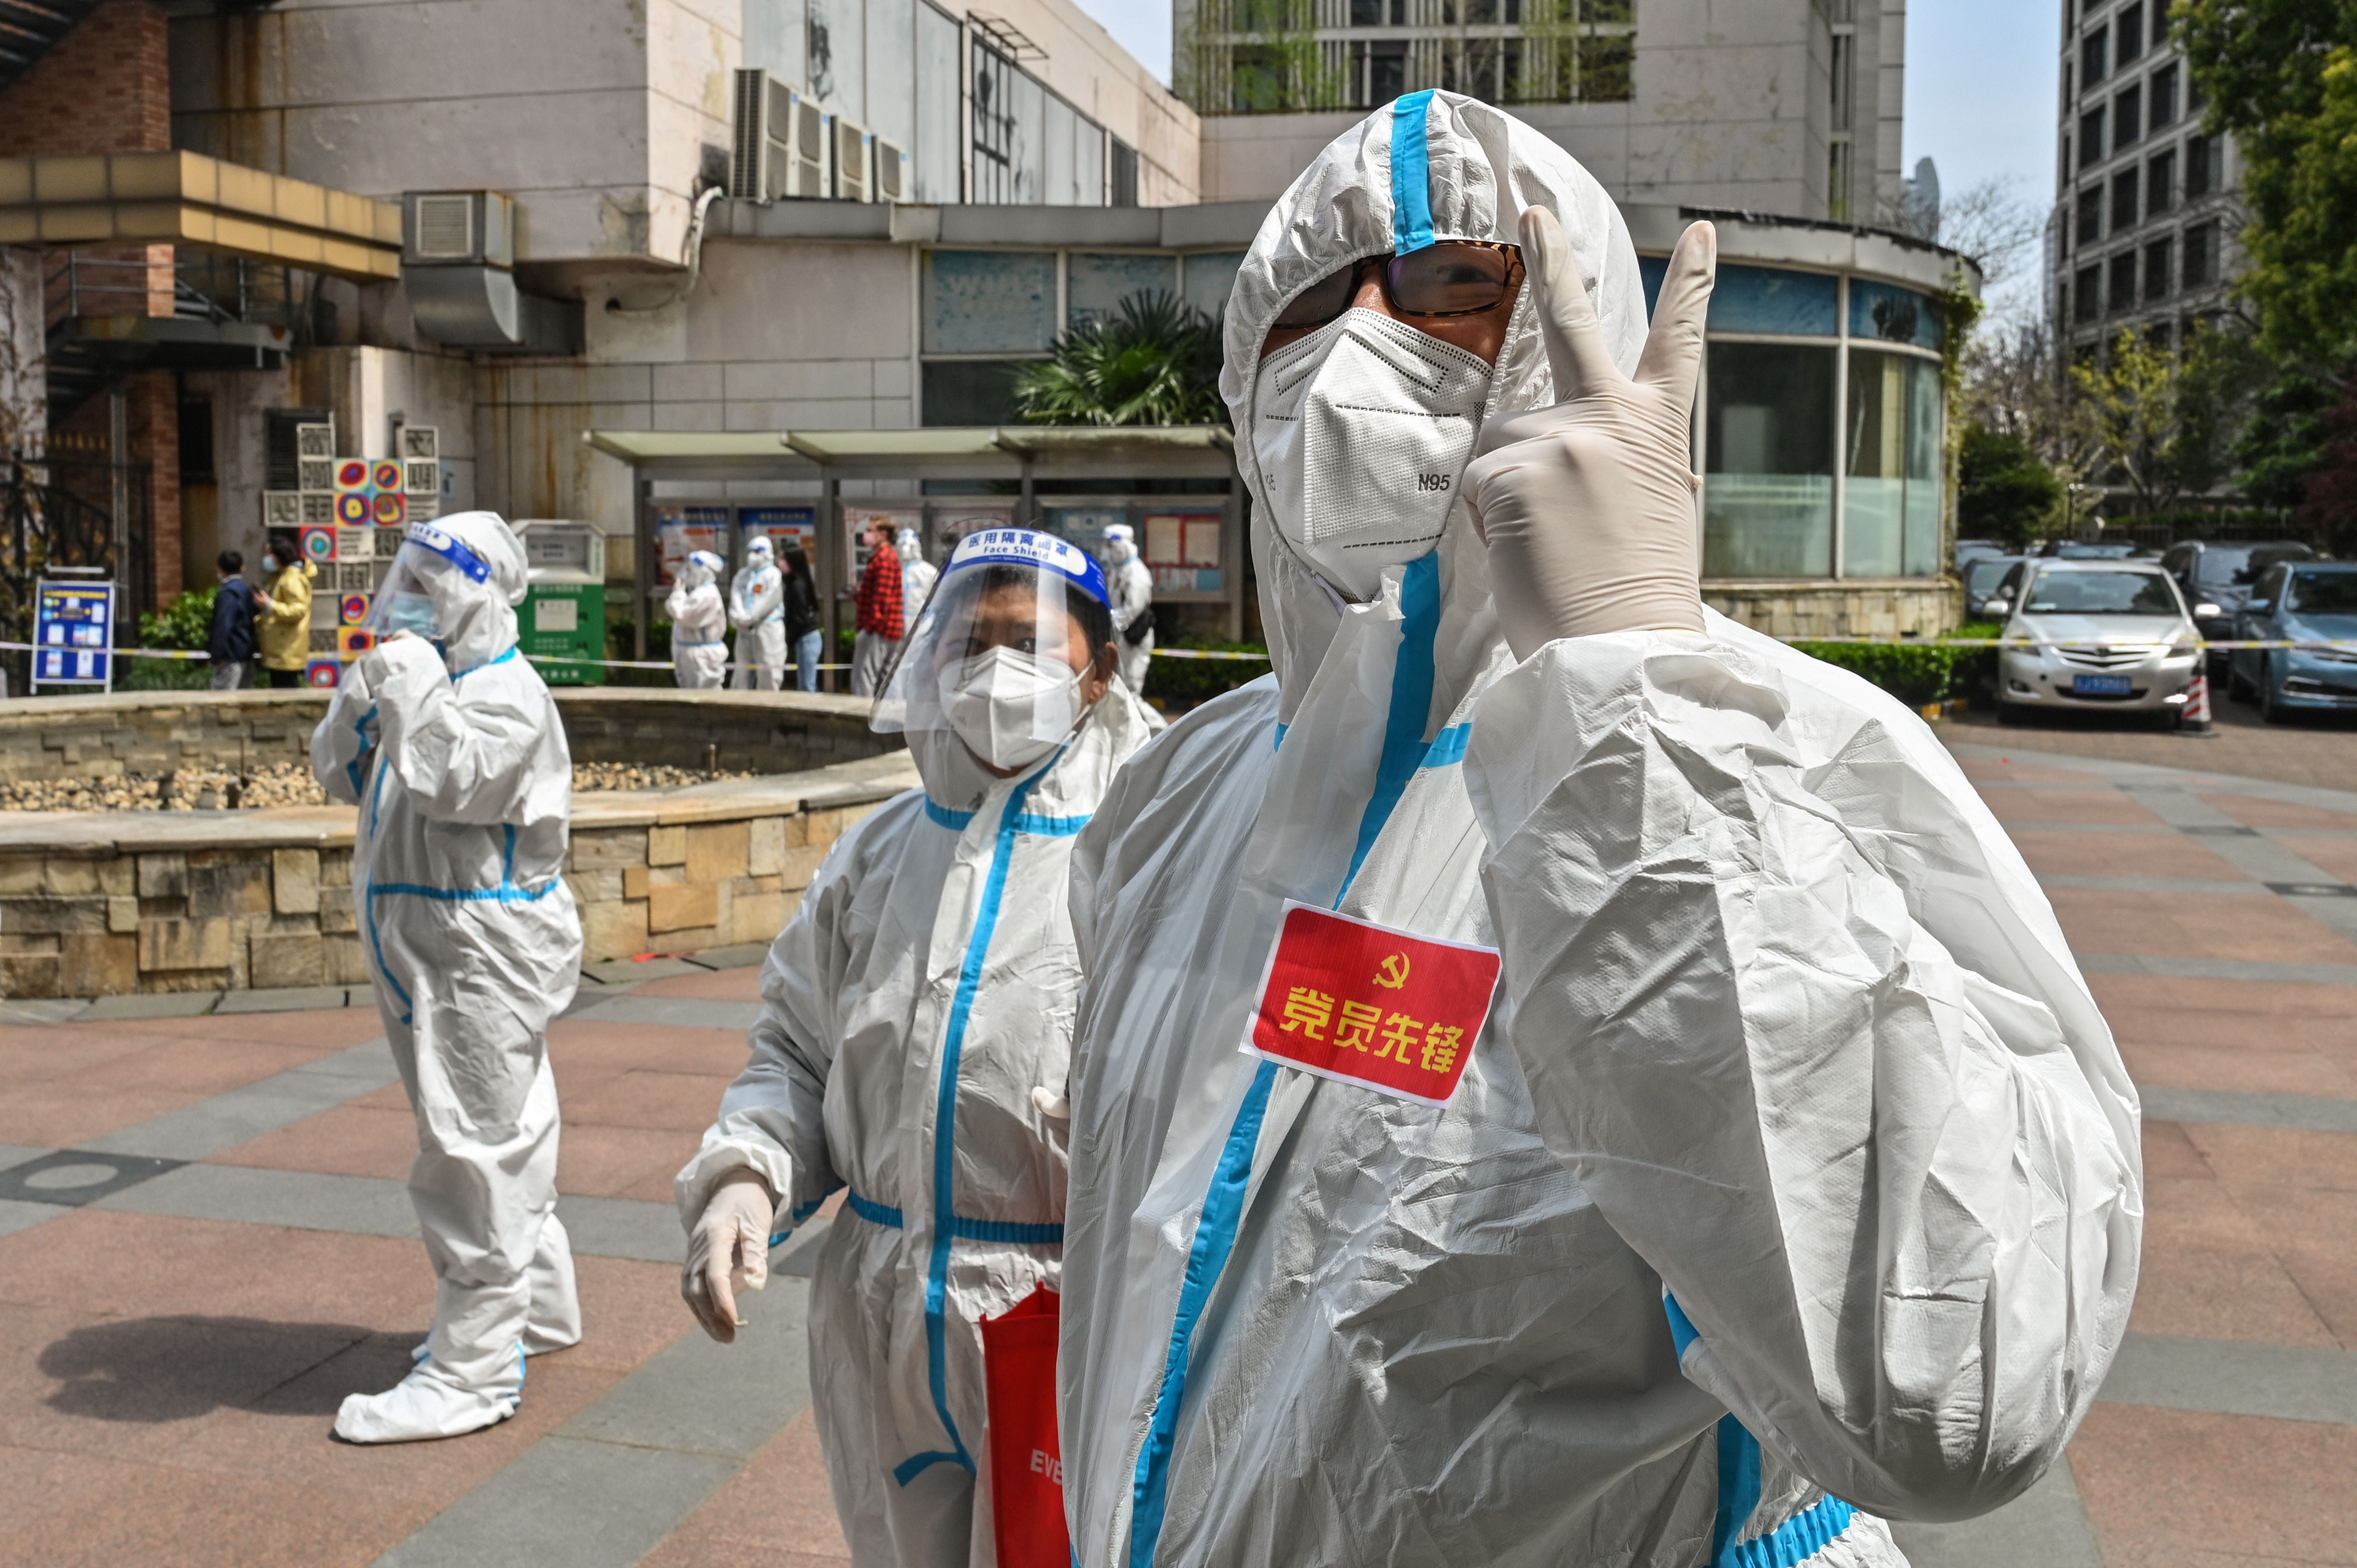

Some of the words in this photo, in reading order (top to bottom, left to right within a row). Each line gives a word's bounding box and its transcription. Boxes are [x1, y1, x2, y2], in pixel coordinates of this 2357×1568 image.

[1419, 474, 1451, 491] N95
[969, 531, 1068, 556] 医用隔离面罩
[1014, 546, 1049, 560] Shield
[1279, 986, 1464, 1074] 党员先锋
